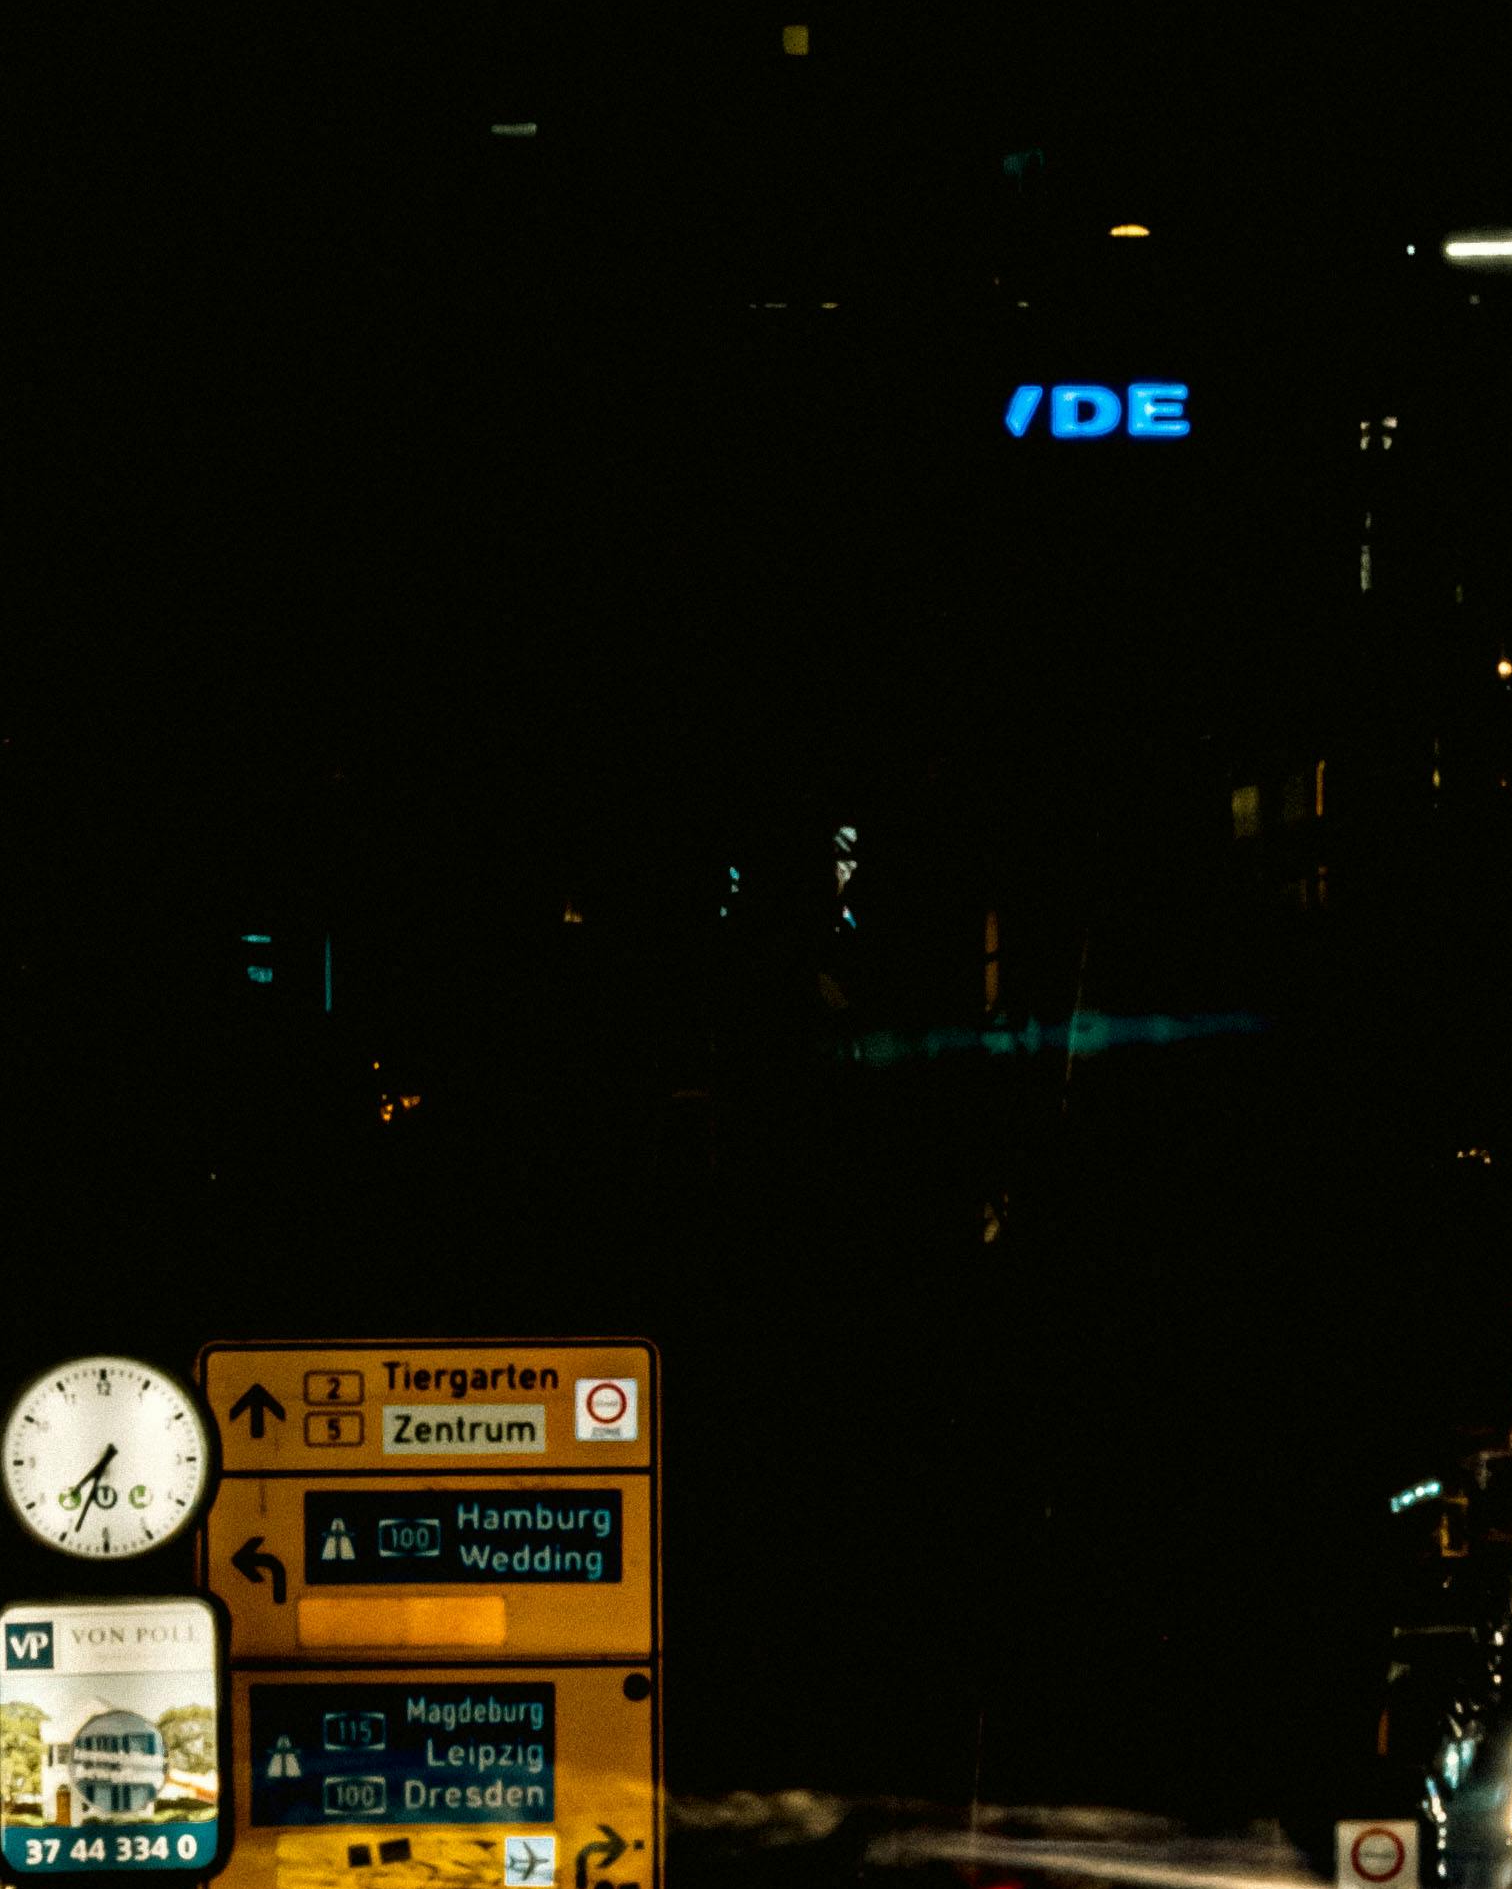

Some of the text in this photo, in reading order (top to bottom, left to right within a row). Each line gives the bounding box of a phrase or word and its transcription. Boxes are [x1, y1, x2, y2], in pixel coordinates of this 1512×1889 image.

[327, 1377, 341, 1400] 2
[382, 1362, 560, 1398] Tiergarten
[327, 1417, 341, 1440] 5
[392, 1414, 536, 1444] Zentrum
[457, 1503, 612, 1538] Hamburg
[391, 1527, 430, 1549] 100
[459, 1544, 605, 1581] Wedding
[9, 1631, 49, 1660] VP
[71, 1626, 125, 1646] VON
[406, 1696, 545, 1732] Magdeburg
[339, 1721, 373, 1744] 115
[426, 1736, 545, 1773] Leipzig
[336, 1784, 376, 1809] 100
[404, 1779, 546, 1809] Dresden
[26, 1833, 198, 1865] 37 44 334 0
